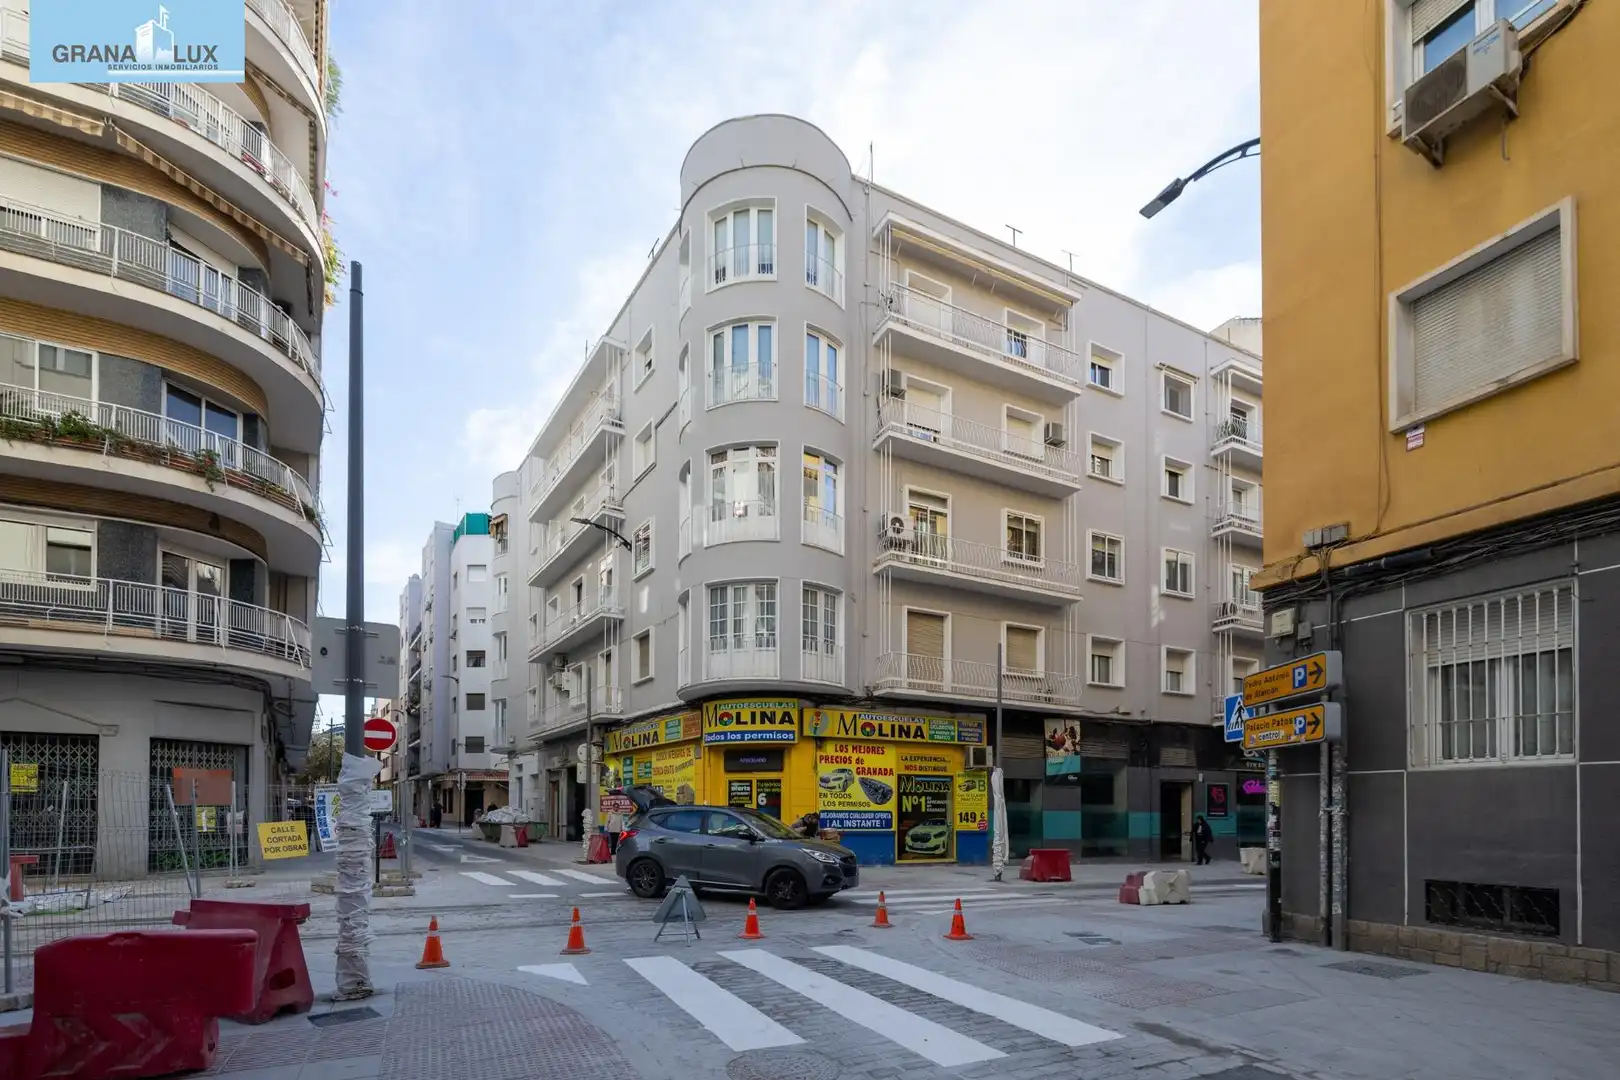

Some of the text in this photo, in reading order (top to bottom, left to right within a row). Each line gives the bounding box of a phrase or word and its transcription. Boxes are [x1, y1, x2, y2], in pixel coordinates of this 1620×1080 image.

[1294, 667, 1305, 688] P
[720, 702, 794, 710] AUTOESCUELAS
[704, 703, 795, 728] MOLINA
[860, 713, 925, 724] AUTOESCUELAS
[837, 712, 926, 739] MOLINA
[1246, 718, 1293, 731] Palacio Patos
[1295, 716, 1305, 735] P
[613, 730, 660, 751] MOLINA
[704, 731, 794, 742] Todos los permisos
[834, 744, 885, 755] LOS MEJORES
[819, 755, 865, 765] PRECIOS de
[856, 767, 894, 777] GRANADA
[900, 775, 952, 793] MOLINA
[978, 779, 986, 791] B
[757, 792, 767, 805] 6
[958, 812, 977, 823] 149
[843, 820, 882, 828] INSTANTE
[270, 826, 296, 834] CALLE
[266, 835, 303, 844] CORTADA
[264, 844, 308, 854] POR OBRAS
